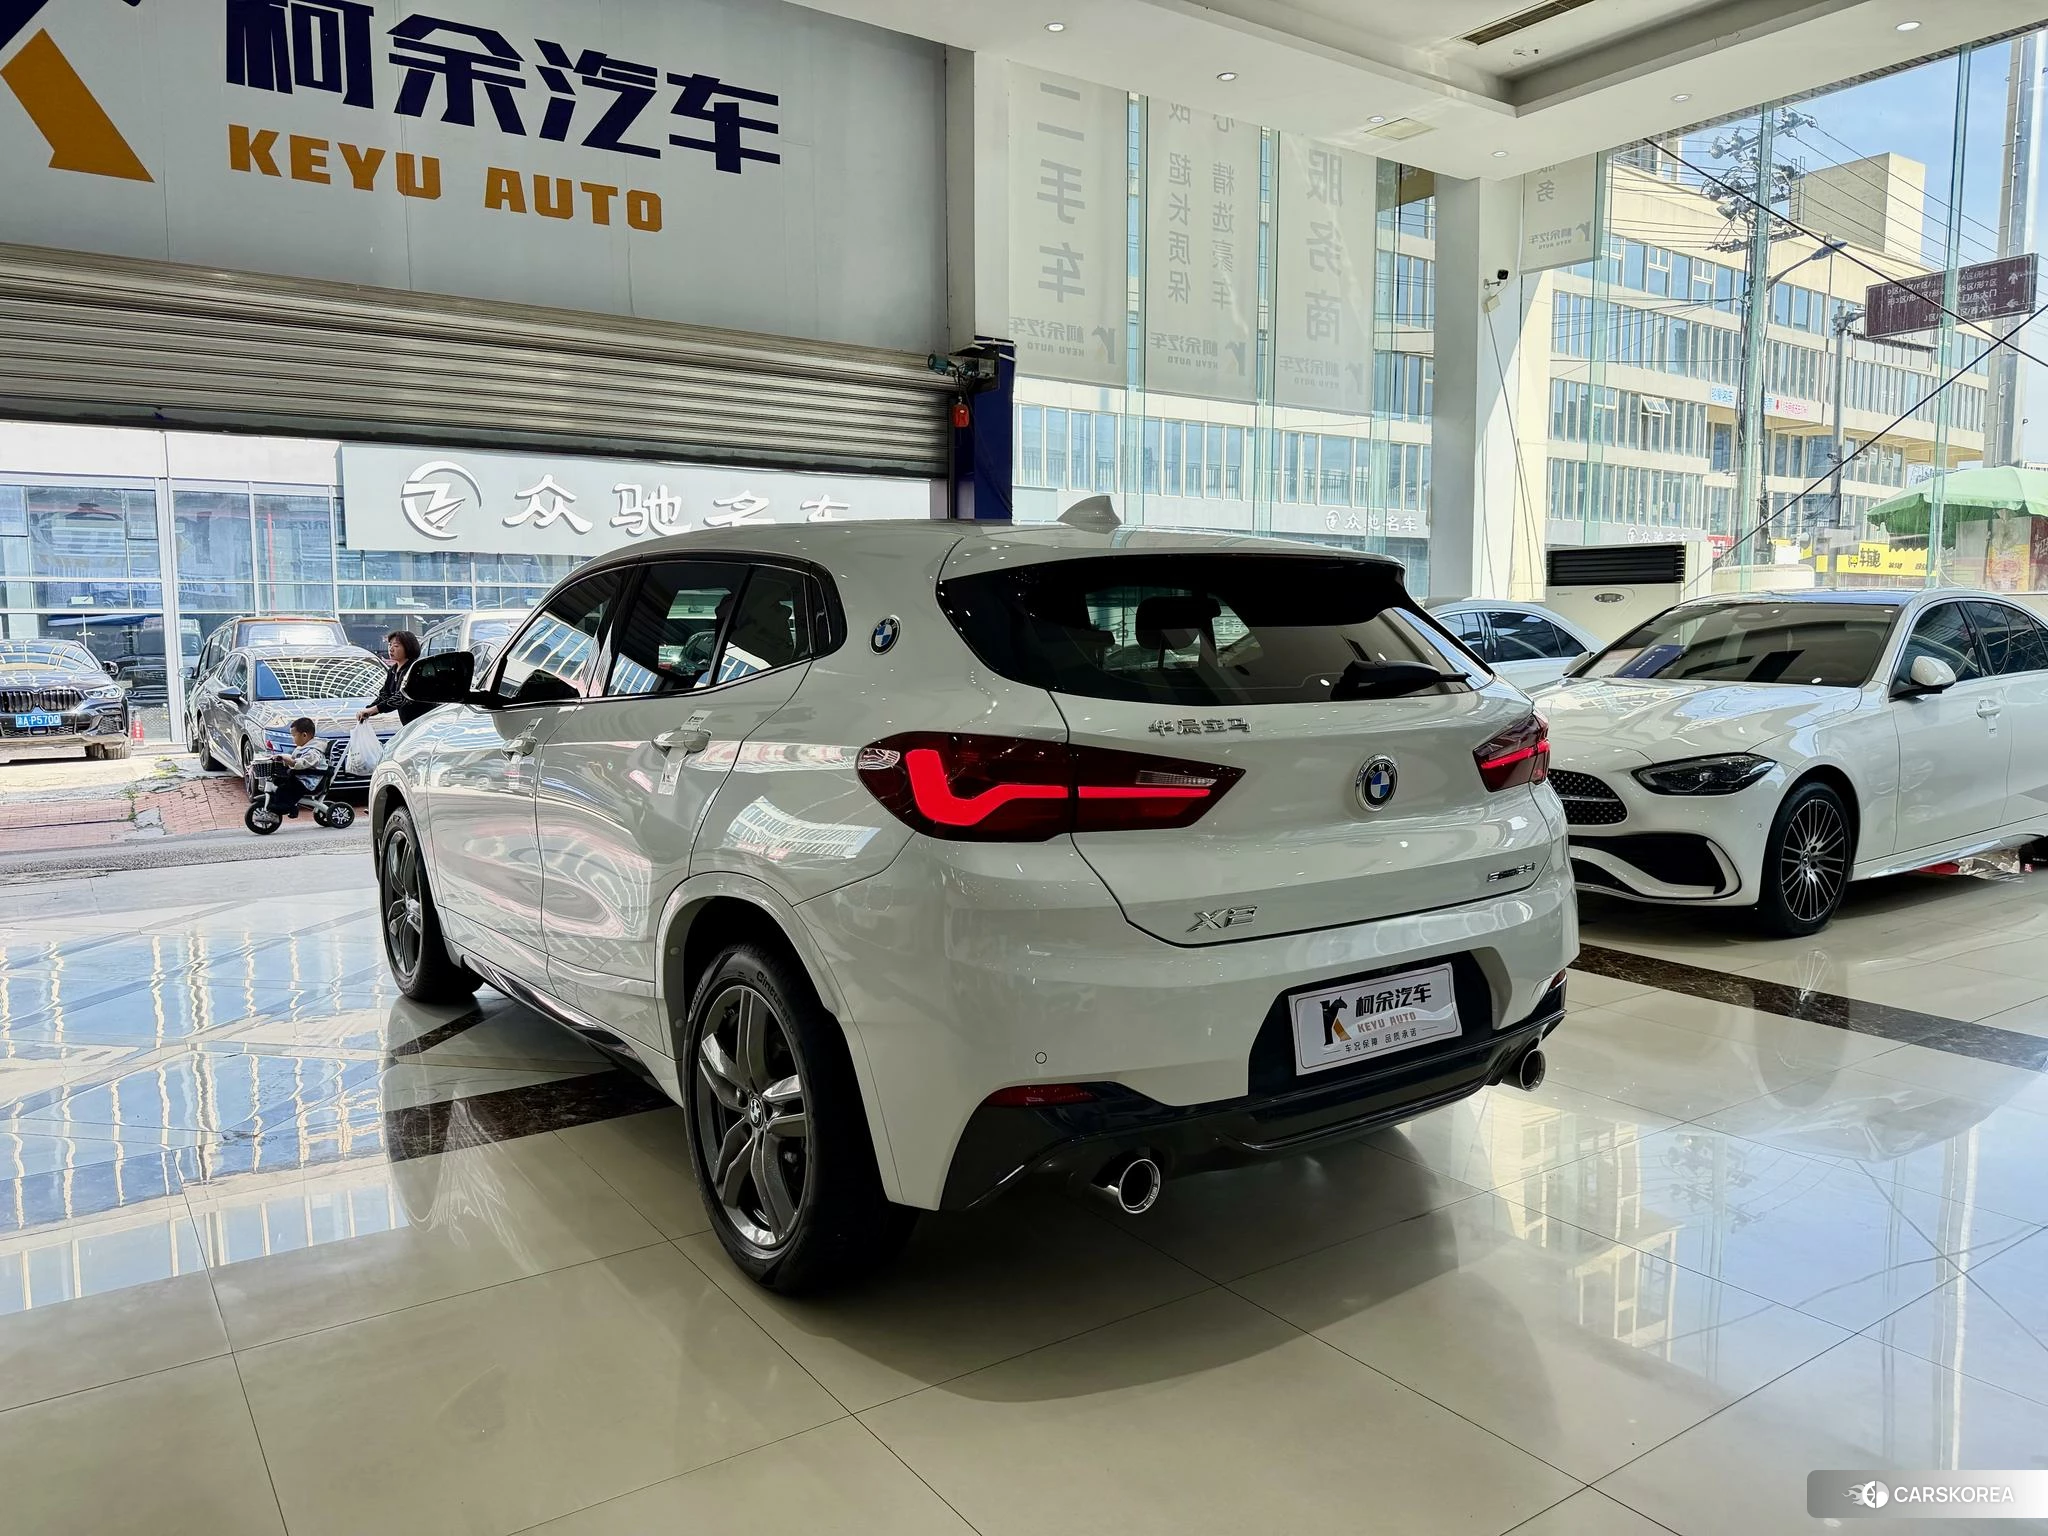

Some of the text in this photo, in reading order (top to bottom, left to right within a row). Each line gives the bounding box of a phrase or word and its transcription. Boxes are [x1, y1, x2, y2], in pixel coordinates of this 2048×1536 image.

[226, 0, 781, 174] 柯余汽车
[229, 124, 663, 232] KEYU AUTO
[1185, 904, 1259, 933] X2
[1355, 982, 1432, 1018] 柯余汽车
[1357, 1011, 1417, 1034] KEYU AUTO
[1345, 1028, 1418, 1053] 车况保障 品质承诺
